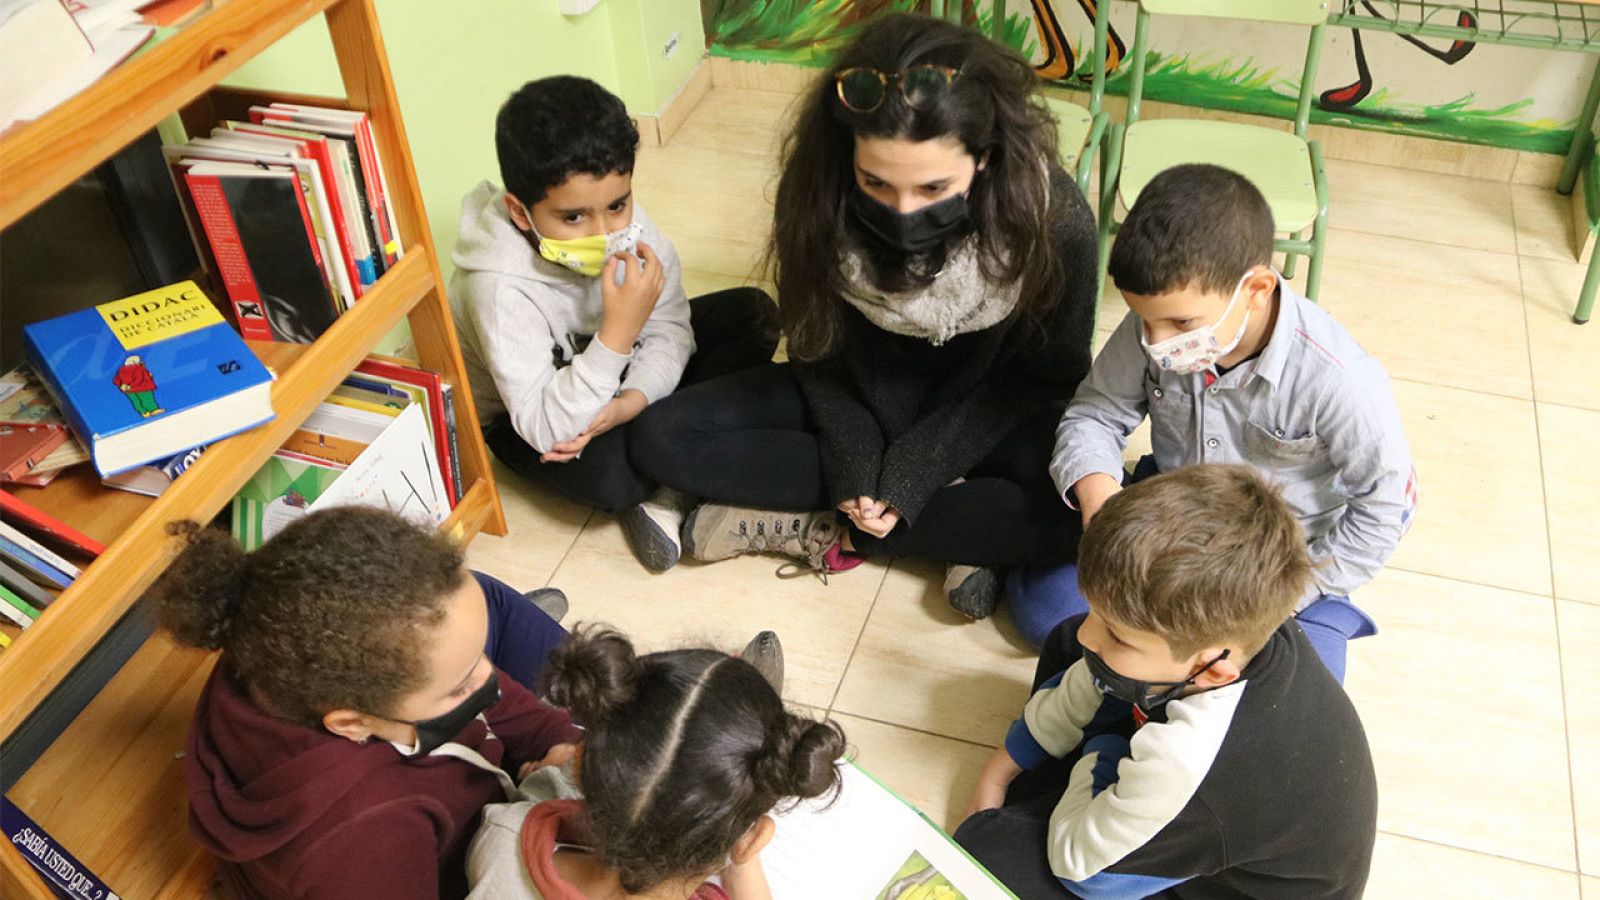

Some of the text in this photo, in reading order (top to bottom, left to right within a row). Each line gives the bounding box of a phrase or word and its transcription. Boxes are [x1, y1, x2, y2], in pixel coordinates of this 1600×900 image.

[110, 290, 197, 322] DIDAC
[120, 304, 206, 333] DICCIONARI
[123, 327, 141, 338] DE
[44, 848, 76, 881] USTED
